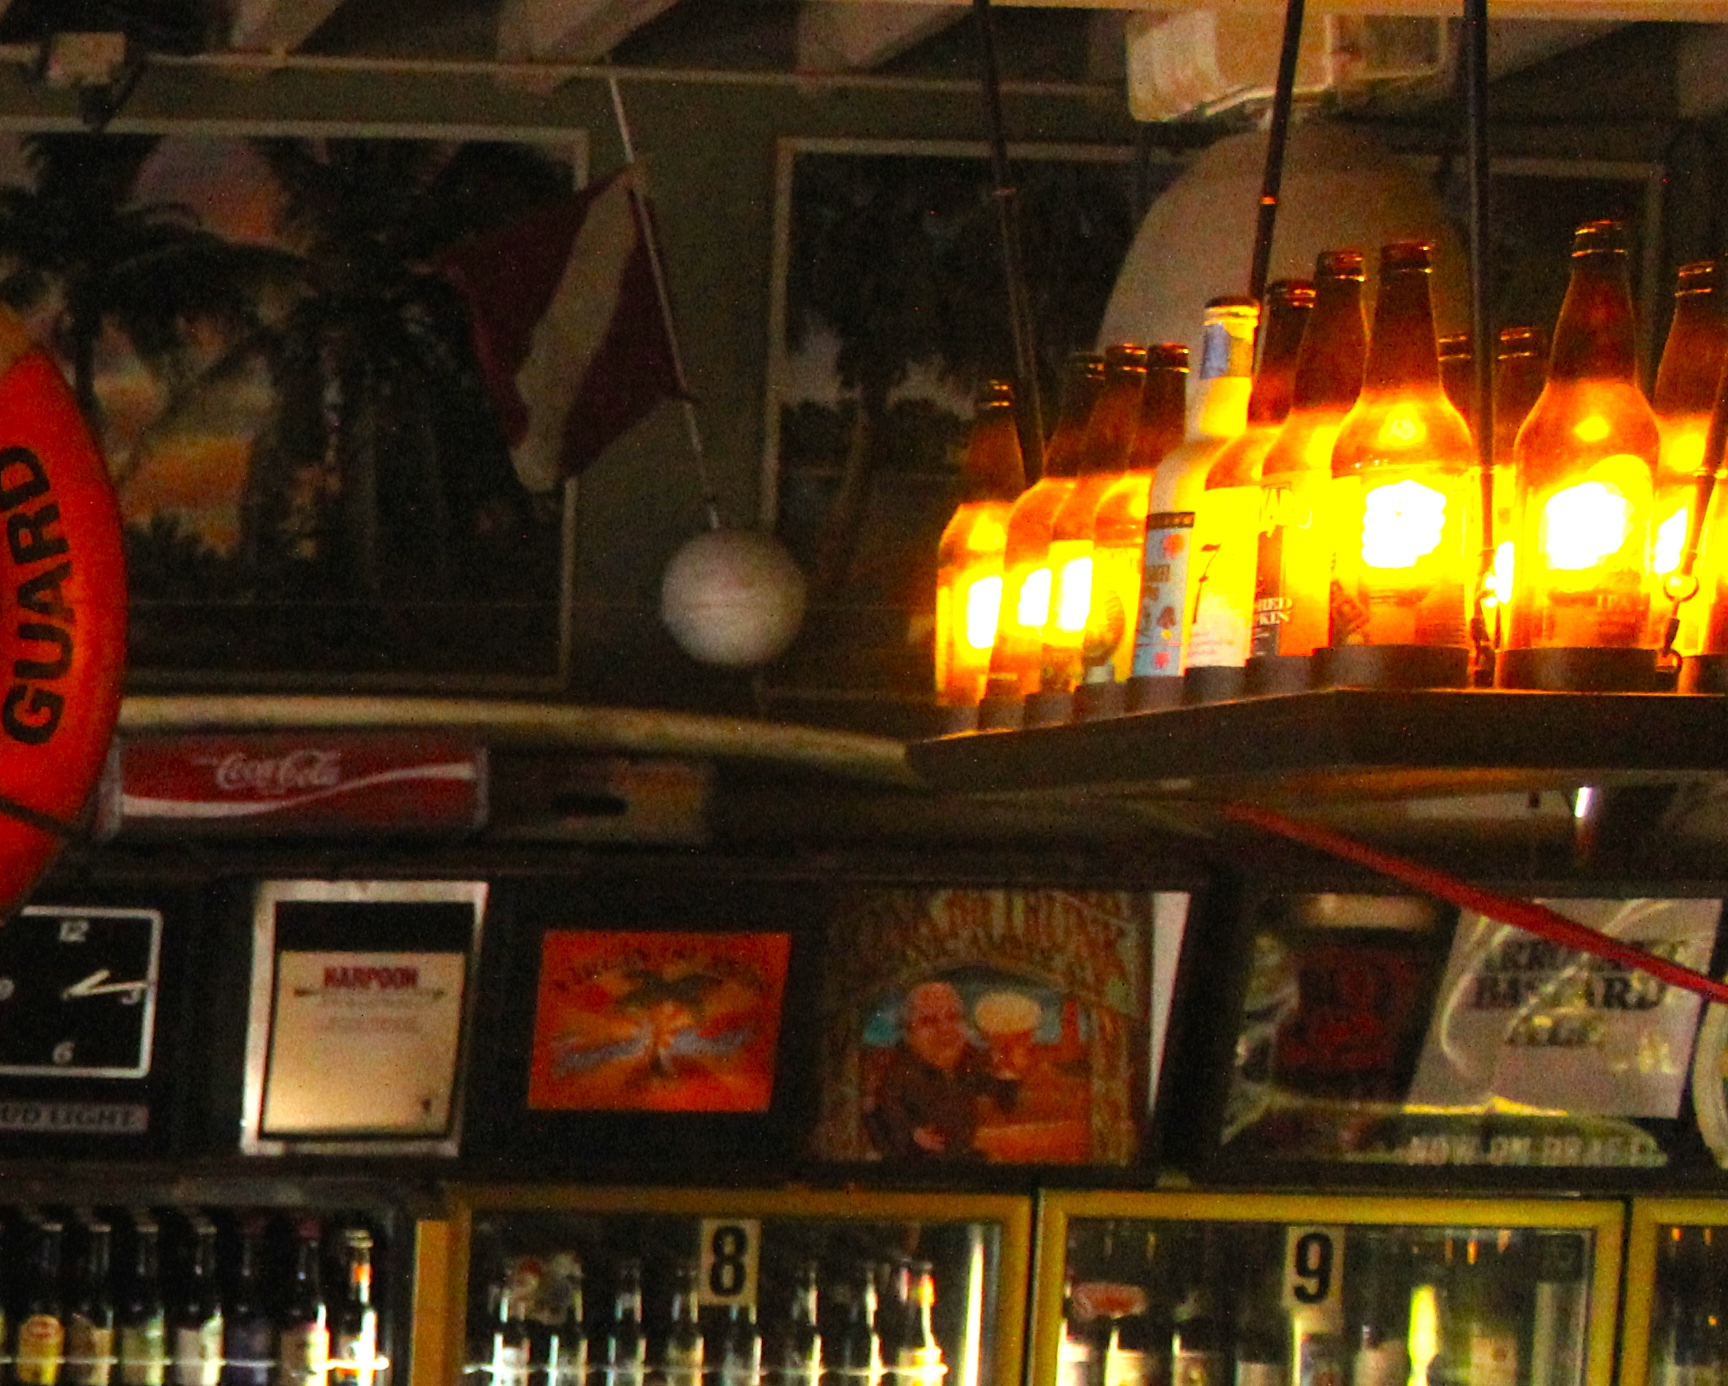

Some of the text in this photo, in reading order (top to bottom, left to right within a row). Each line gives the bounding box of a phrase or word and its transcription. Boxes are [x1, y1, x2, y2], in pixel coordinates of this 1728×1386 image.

[215, 749, 341, 793] Coca-Cola
[709, 1225, 747, 1298] 8
[1293, 1232, 1335, 1304] 9
